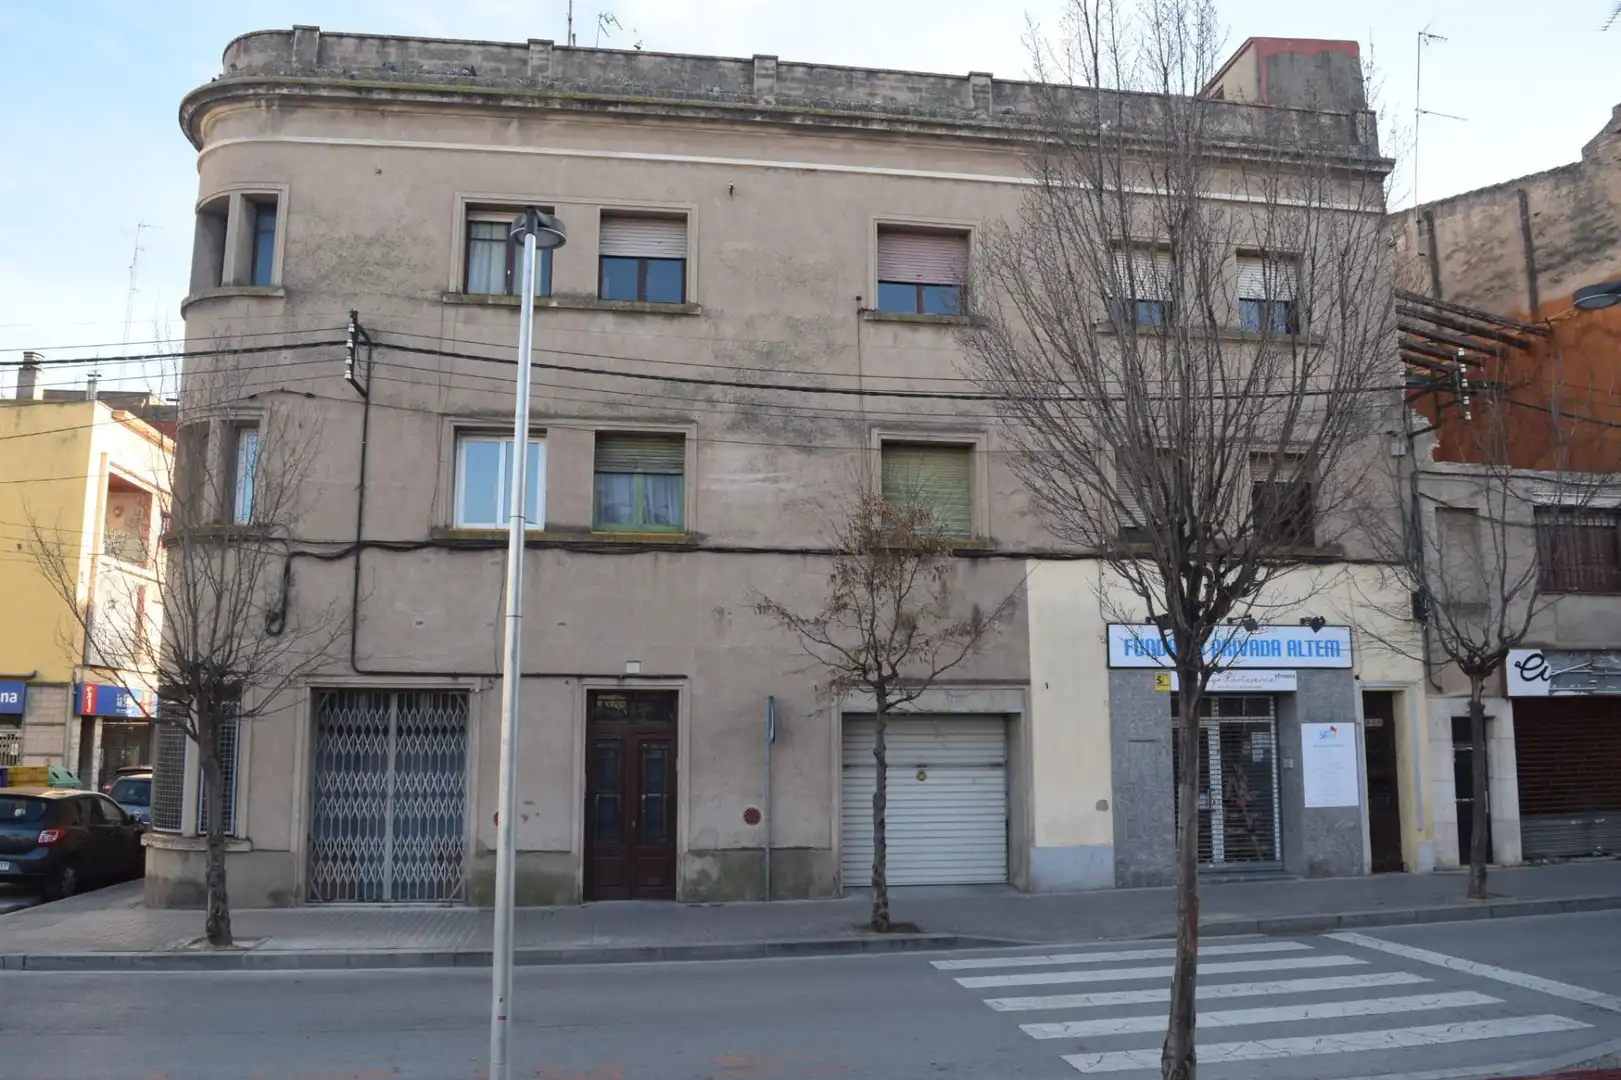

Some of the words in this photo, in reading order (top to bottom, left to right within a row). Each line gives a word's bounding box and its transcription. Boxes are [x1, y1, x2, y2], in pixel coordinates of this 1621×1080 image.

[1211, 638, 1281, 657] PRIVADA
[1287, 639, 1340, 657] ALTEM
[0, 692, 18, 703] na
